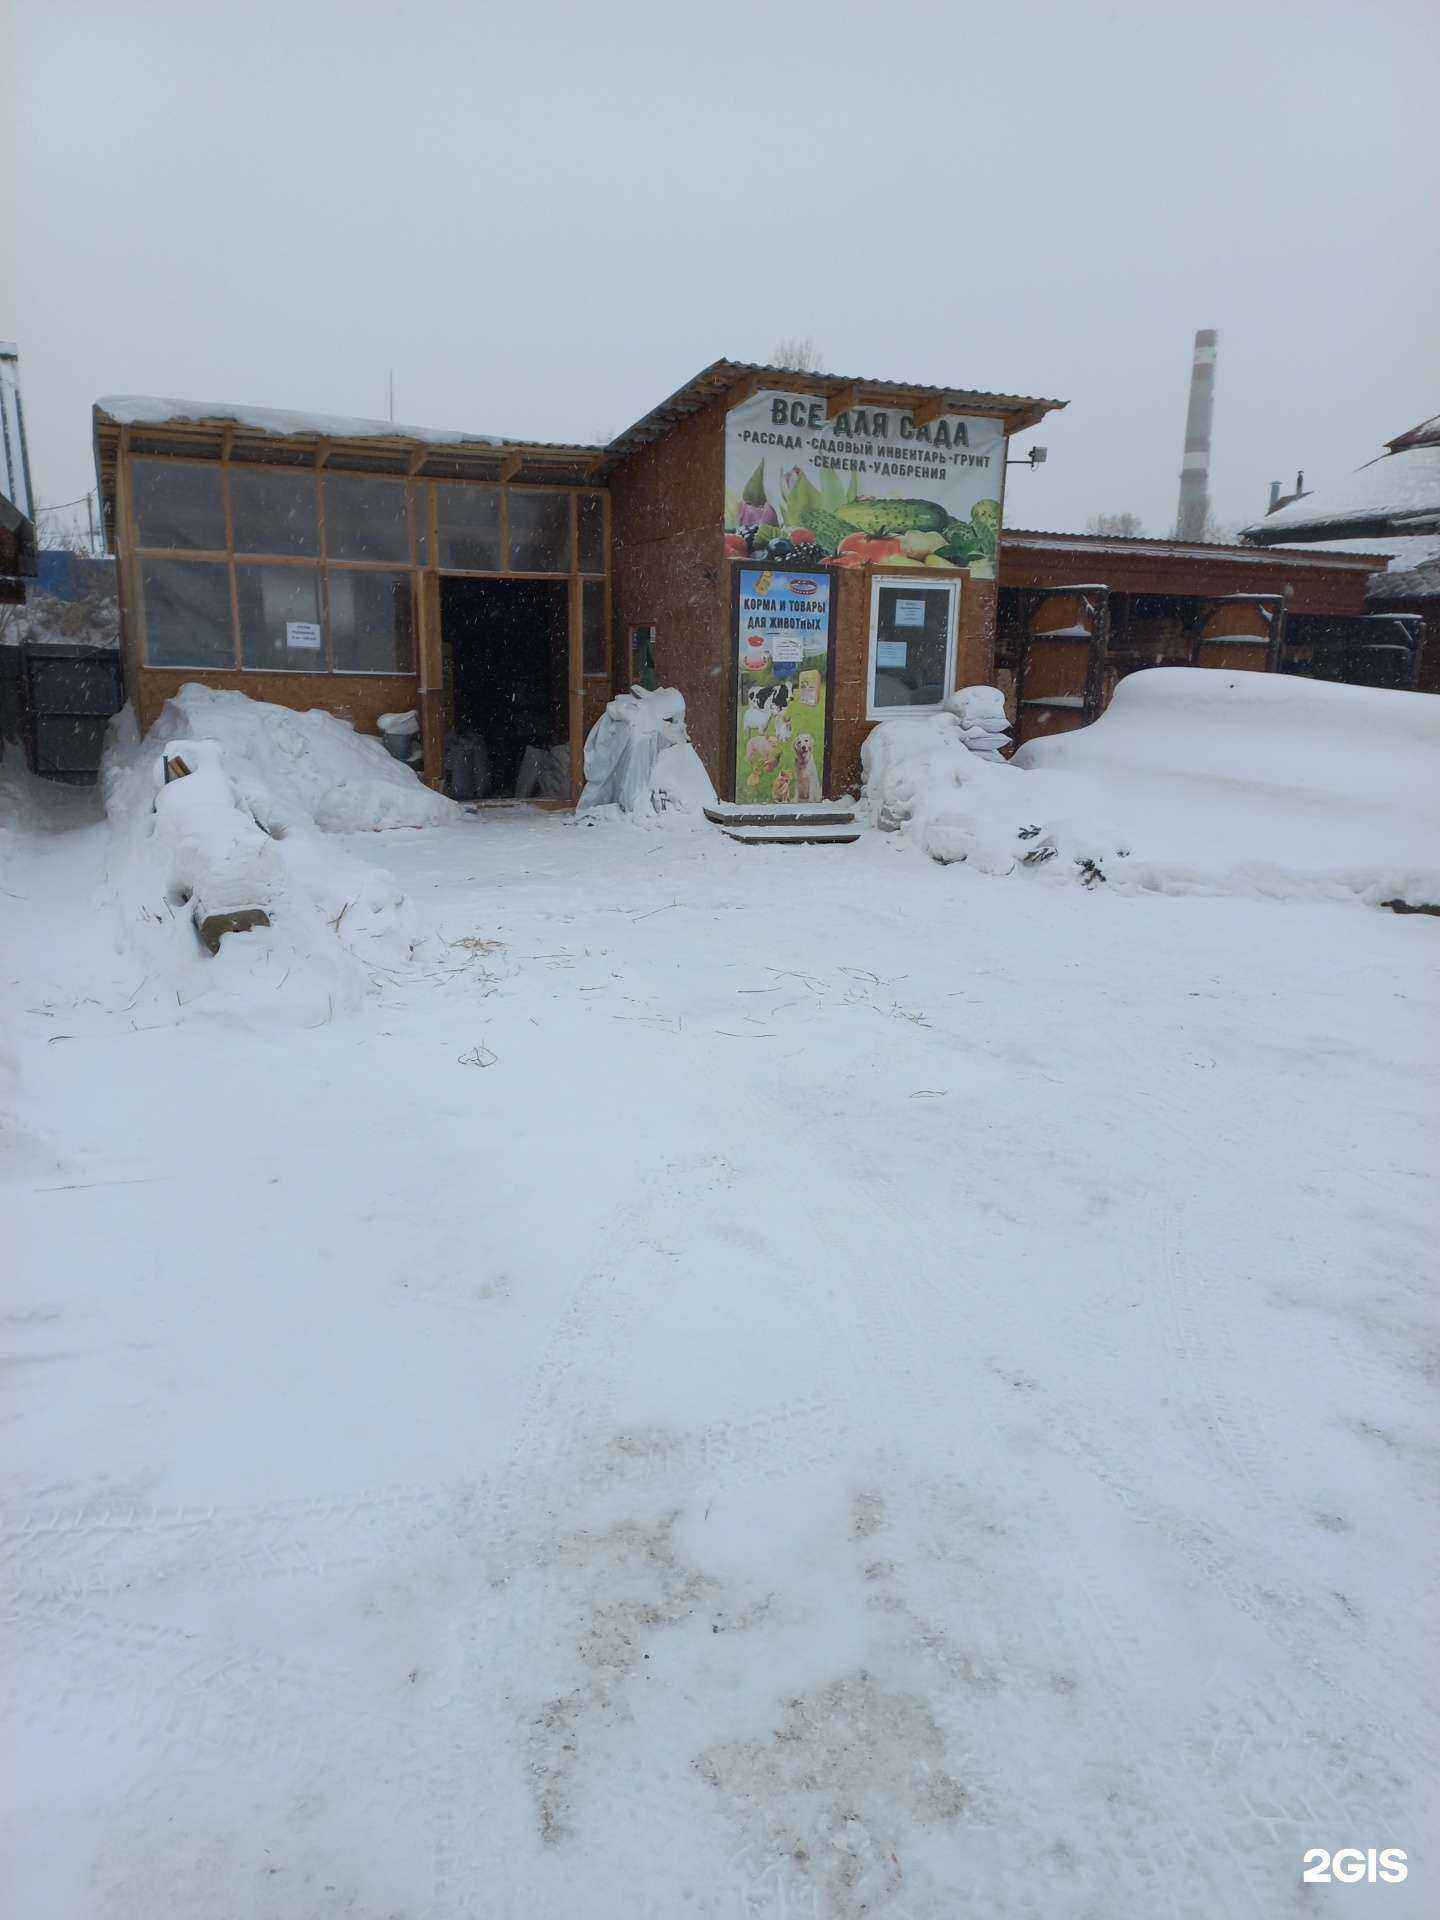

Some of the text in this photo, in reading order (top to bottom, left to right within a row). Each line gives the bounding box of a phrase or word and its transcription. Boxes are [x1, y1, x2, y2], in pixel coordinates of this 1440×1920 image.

[771, 398, 969, 449] ВСЕ ДЛЯ САДА
[877, 445, 946, 463] ИНВЕНТАРЬ
[744, 598, 826, 613] КОРМА И ТОВАРЫ
[747, 617, 821, 630] ДЛЯ ЖИВОТНЫХ
